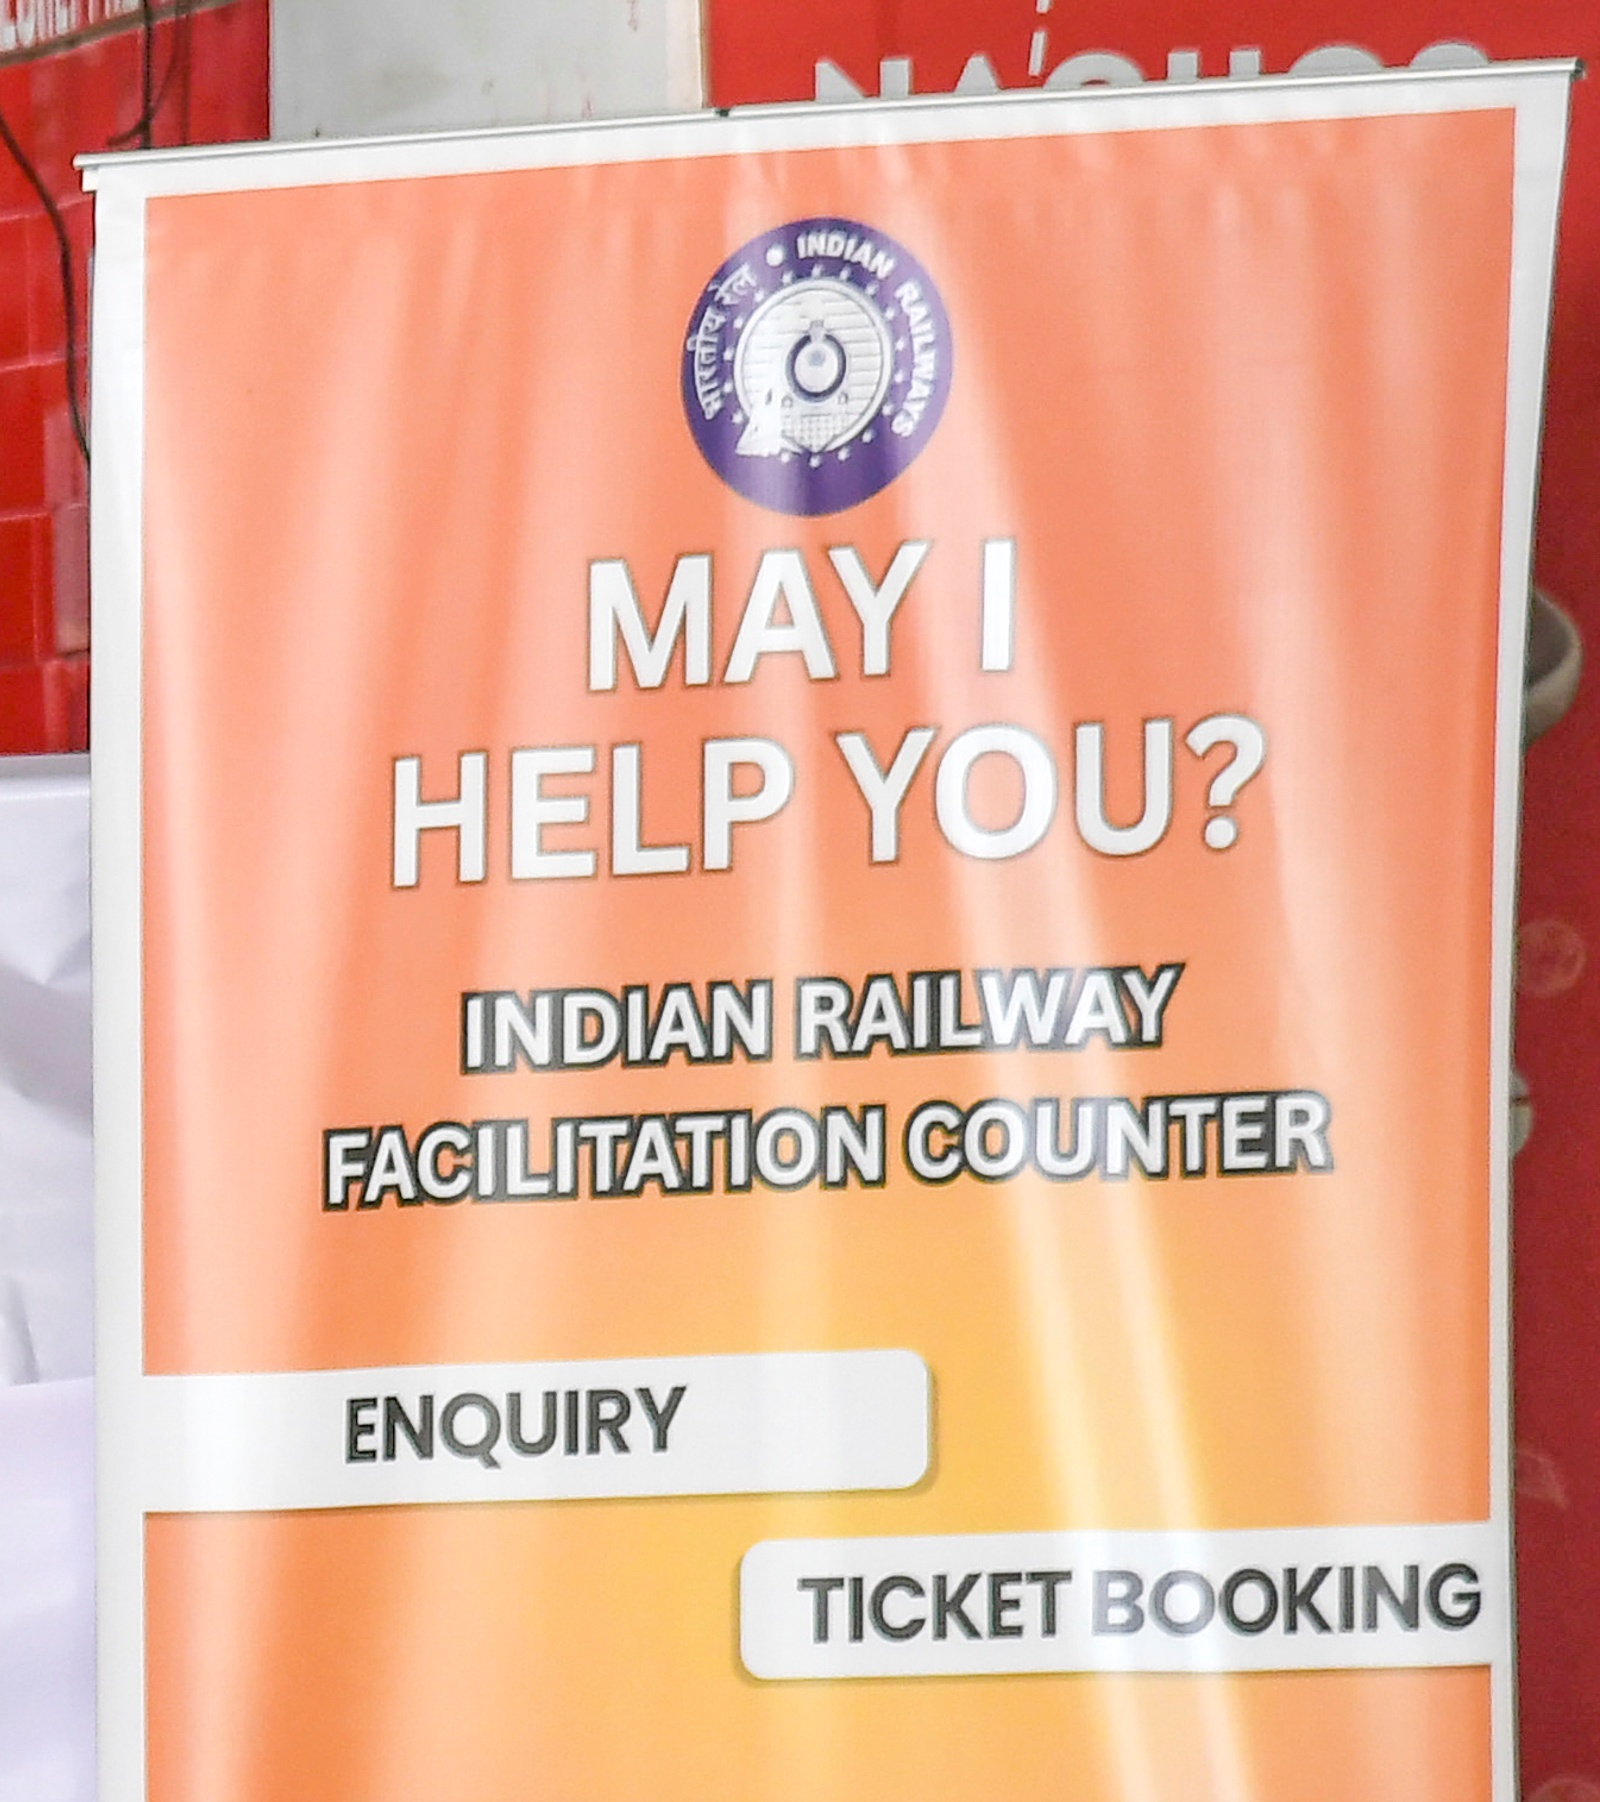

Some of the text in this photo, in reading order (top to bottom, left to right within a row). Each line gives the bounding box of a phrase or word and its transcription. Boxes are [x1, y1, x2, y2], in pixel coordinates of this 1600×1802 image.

[687, 262, 758, 421] भारतीय रेल
[796, 230, 937, 437] INDIAN RAILWAYS
[588, 536, 1017, 692] MAY I
[390, 712, 1268, 889] HELP YOU?
[460, 963, 1186, 1074] INDIAN RAILWAY
[322, 1089, 1335, 1211] FACILITATION COUNTER
[344, 1384, 688, 1470] ENQUIRY
[797, 1562, 1483, 1645] TICKET BOOKING
